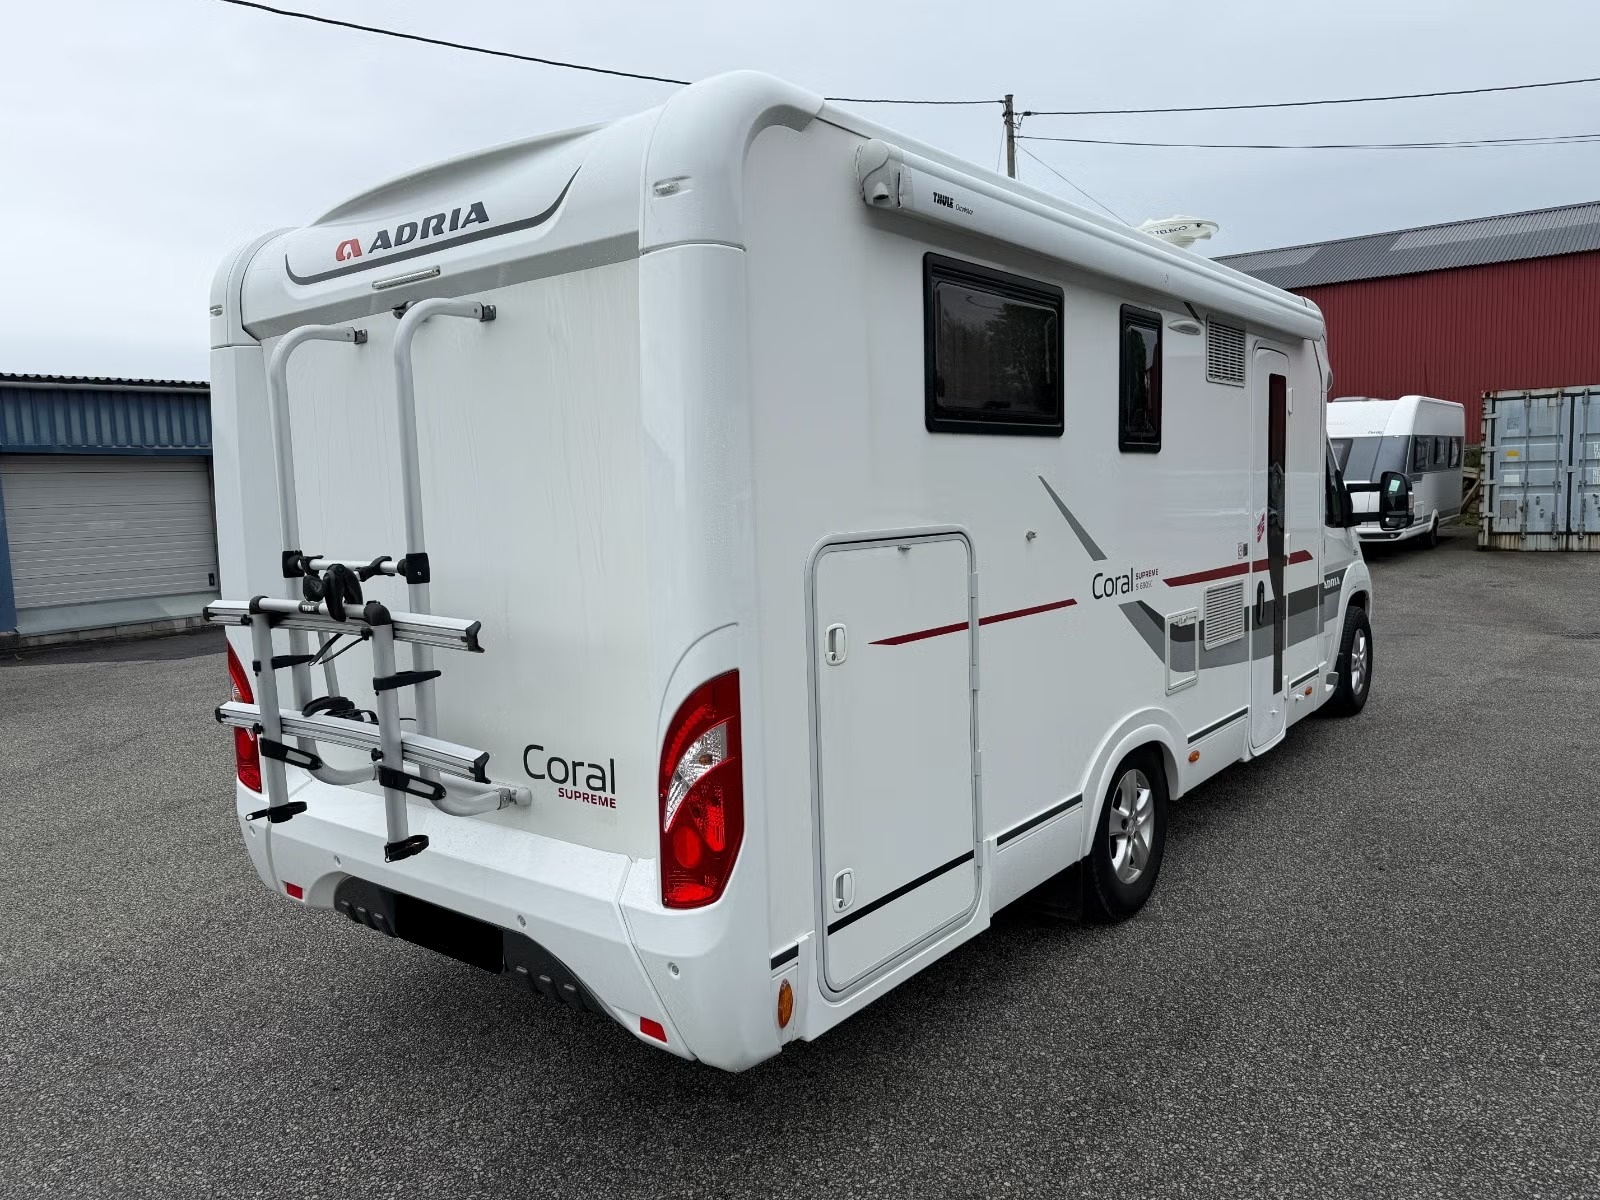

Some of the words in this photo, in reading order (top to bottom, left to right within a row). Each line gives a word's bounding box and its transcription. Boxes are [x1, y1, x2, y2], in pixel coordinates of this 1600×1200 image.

[933, 192, 954, 208] THULE
[368, 201, 489, 254] ADRIA
[1092, 567, 1134, 600] Coral
[1135, 568, 1159, 580] SUPREME
[523, 744, 616, 795] Coral
[558, 787, 617, 809] SUPREME
